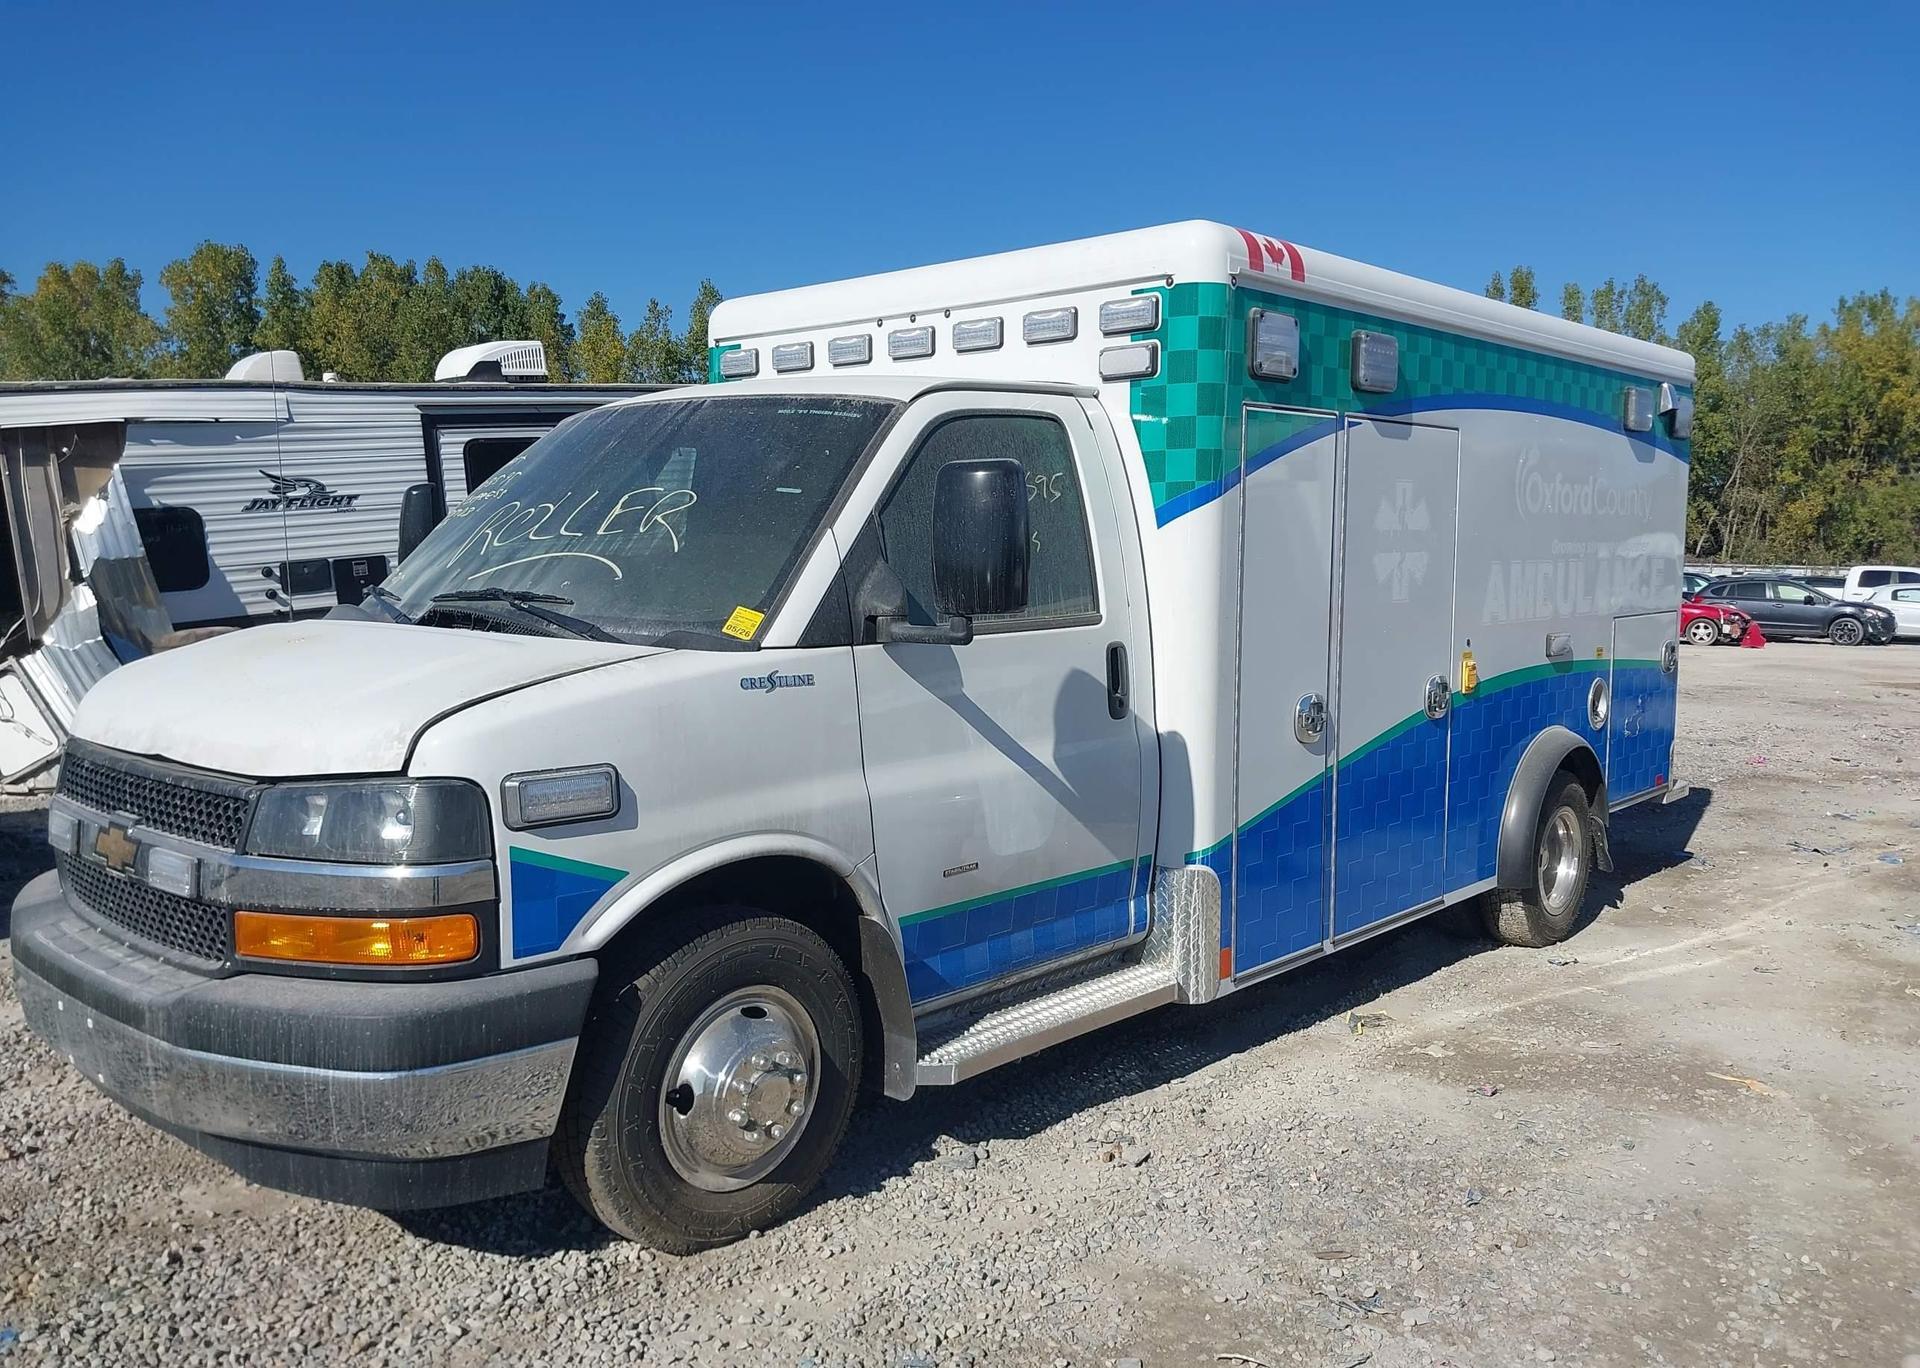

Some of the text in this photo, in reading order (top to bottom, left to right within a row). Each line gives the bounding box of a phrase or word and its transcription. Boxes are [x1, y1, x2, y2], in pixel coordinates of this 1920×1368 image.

[240, 493, 361, 512] JAY FLIGHT
[447, 487, 697, 568] ROLLER
[726, 624, 751, 638] 05/26
[739, 669, 816, 694] CRESTLINE
